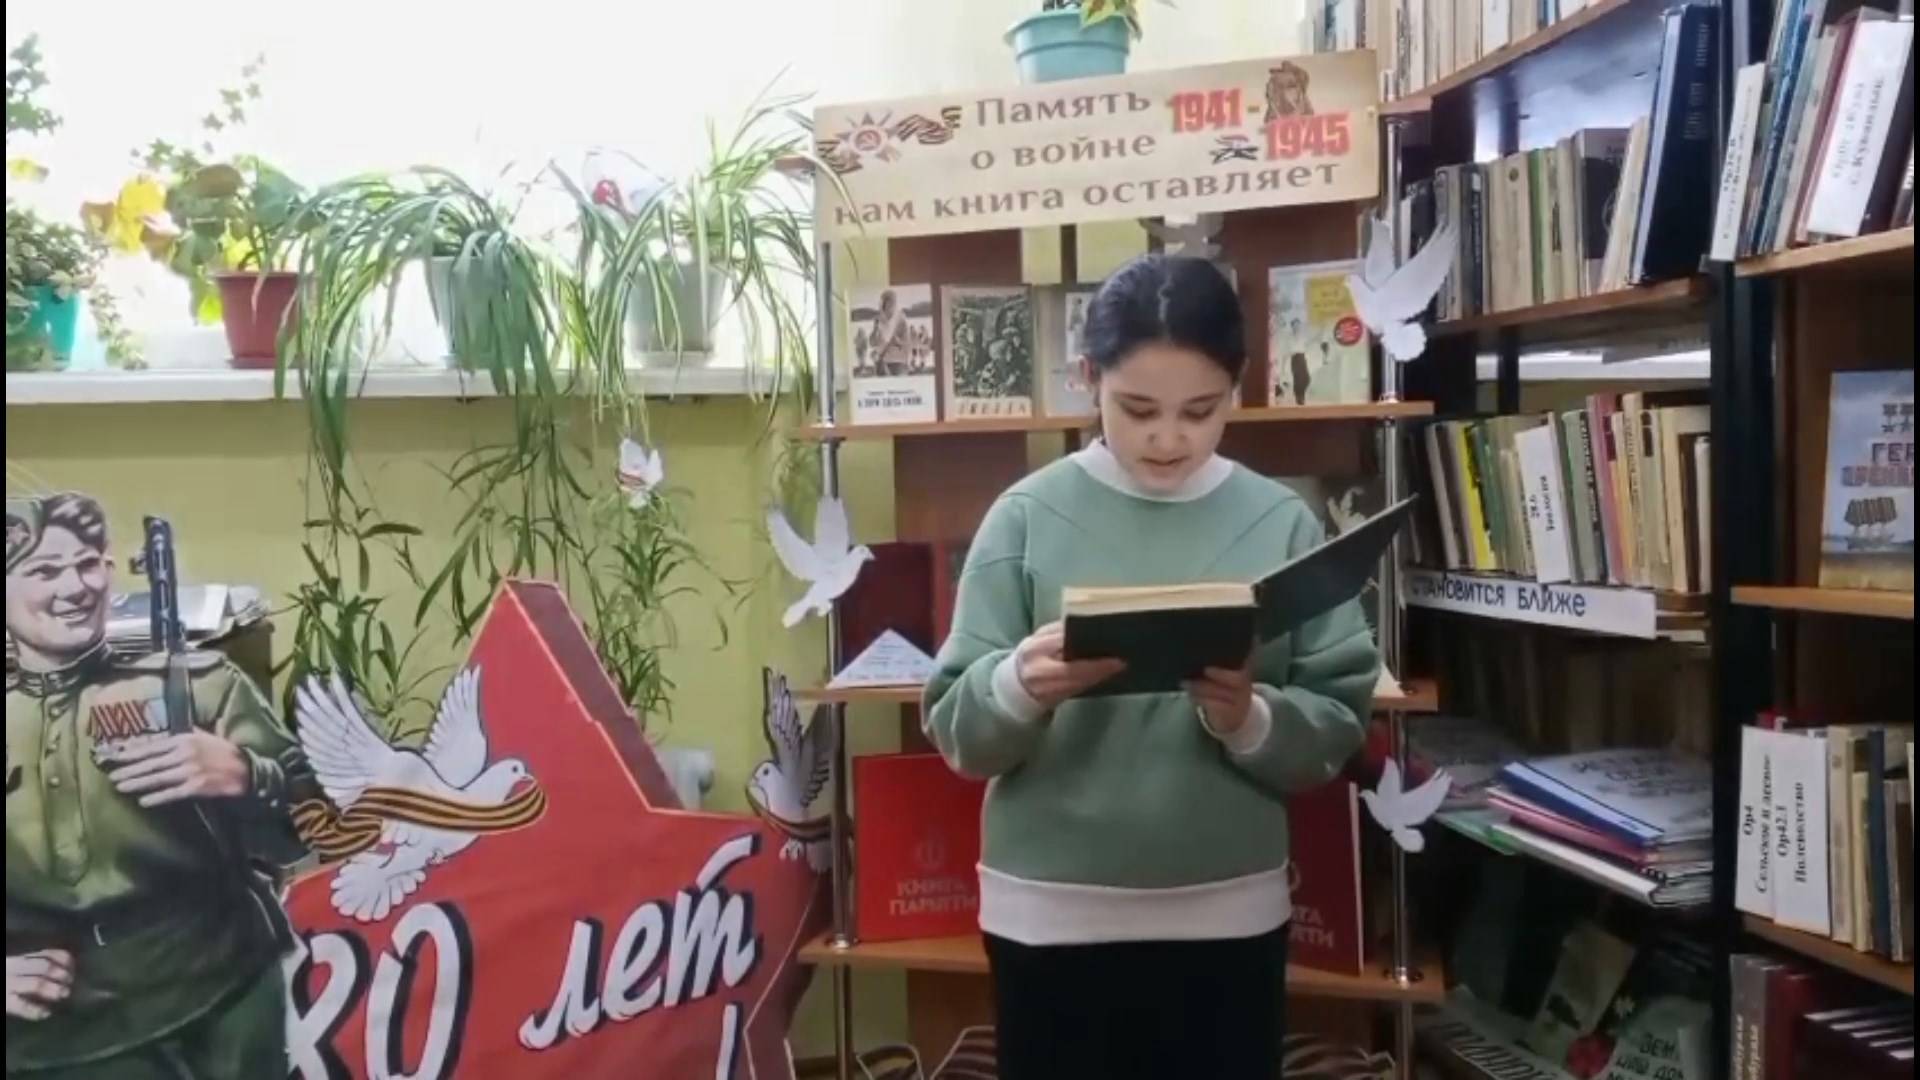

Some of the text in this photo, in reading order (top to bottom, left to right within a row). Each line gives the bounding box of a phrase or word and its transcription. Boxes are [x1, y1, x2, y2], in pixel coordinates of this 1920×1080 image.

[976, 90, 1151, 127] Память
[1168, 88, 1260, 133] 1941-
[971, 133, 1157, 171] о войне
[1265, 113, 1351, 160] 1945
[834, 160, 1340, 228] нам книга оставляет
[518, 834, 764, 1052] лет
